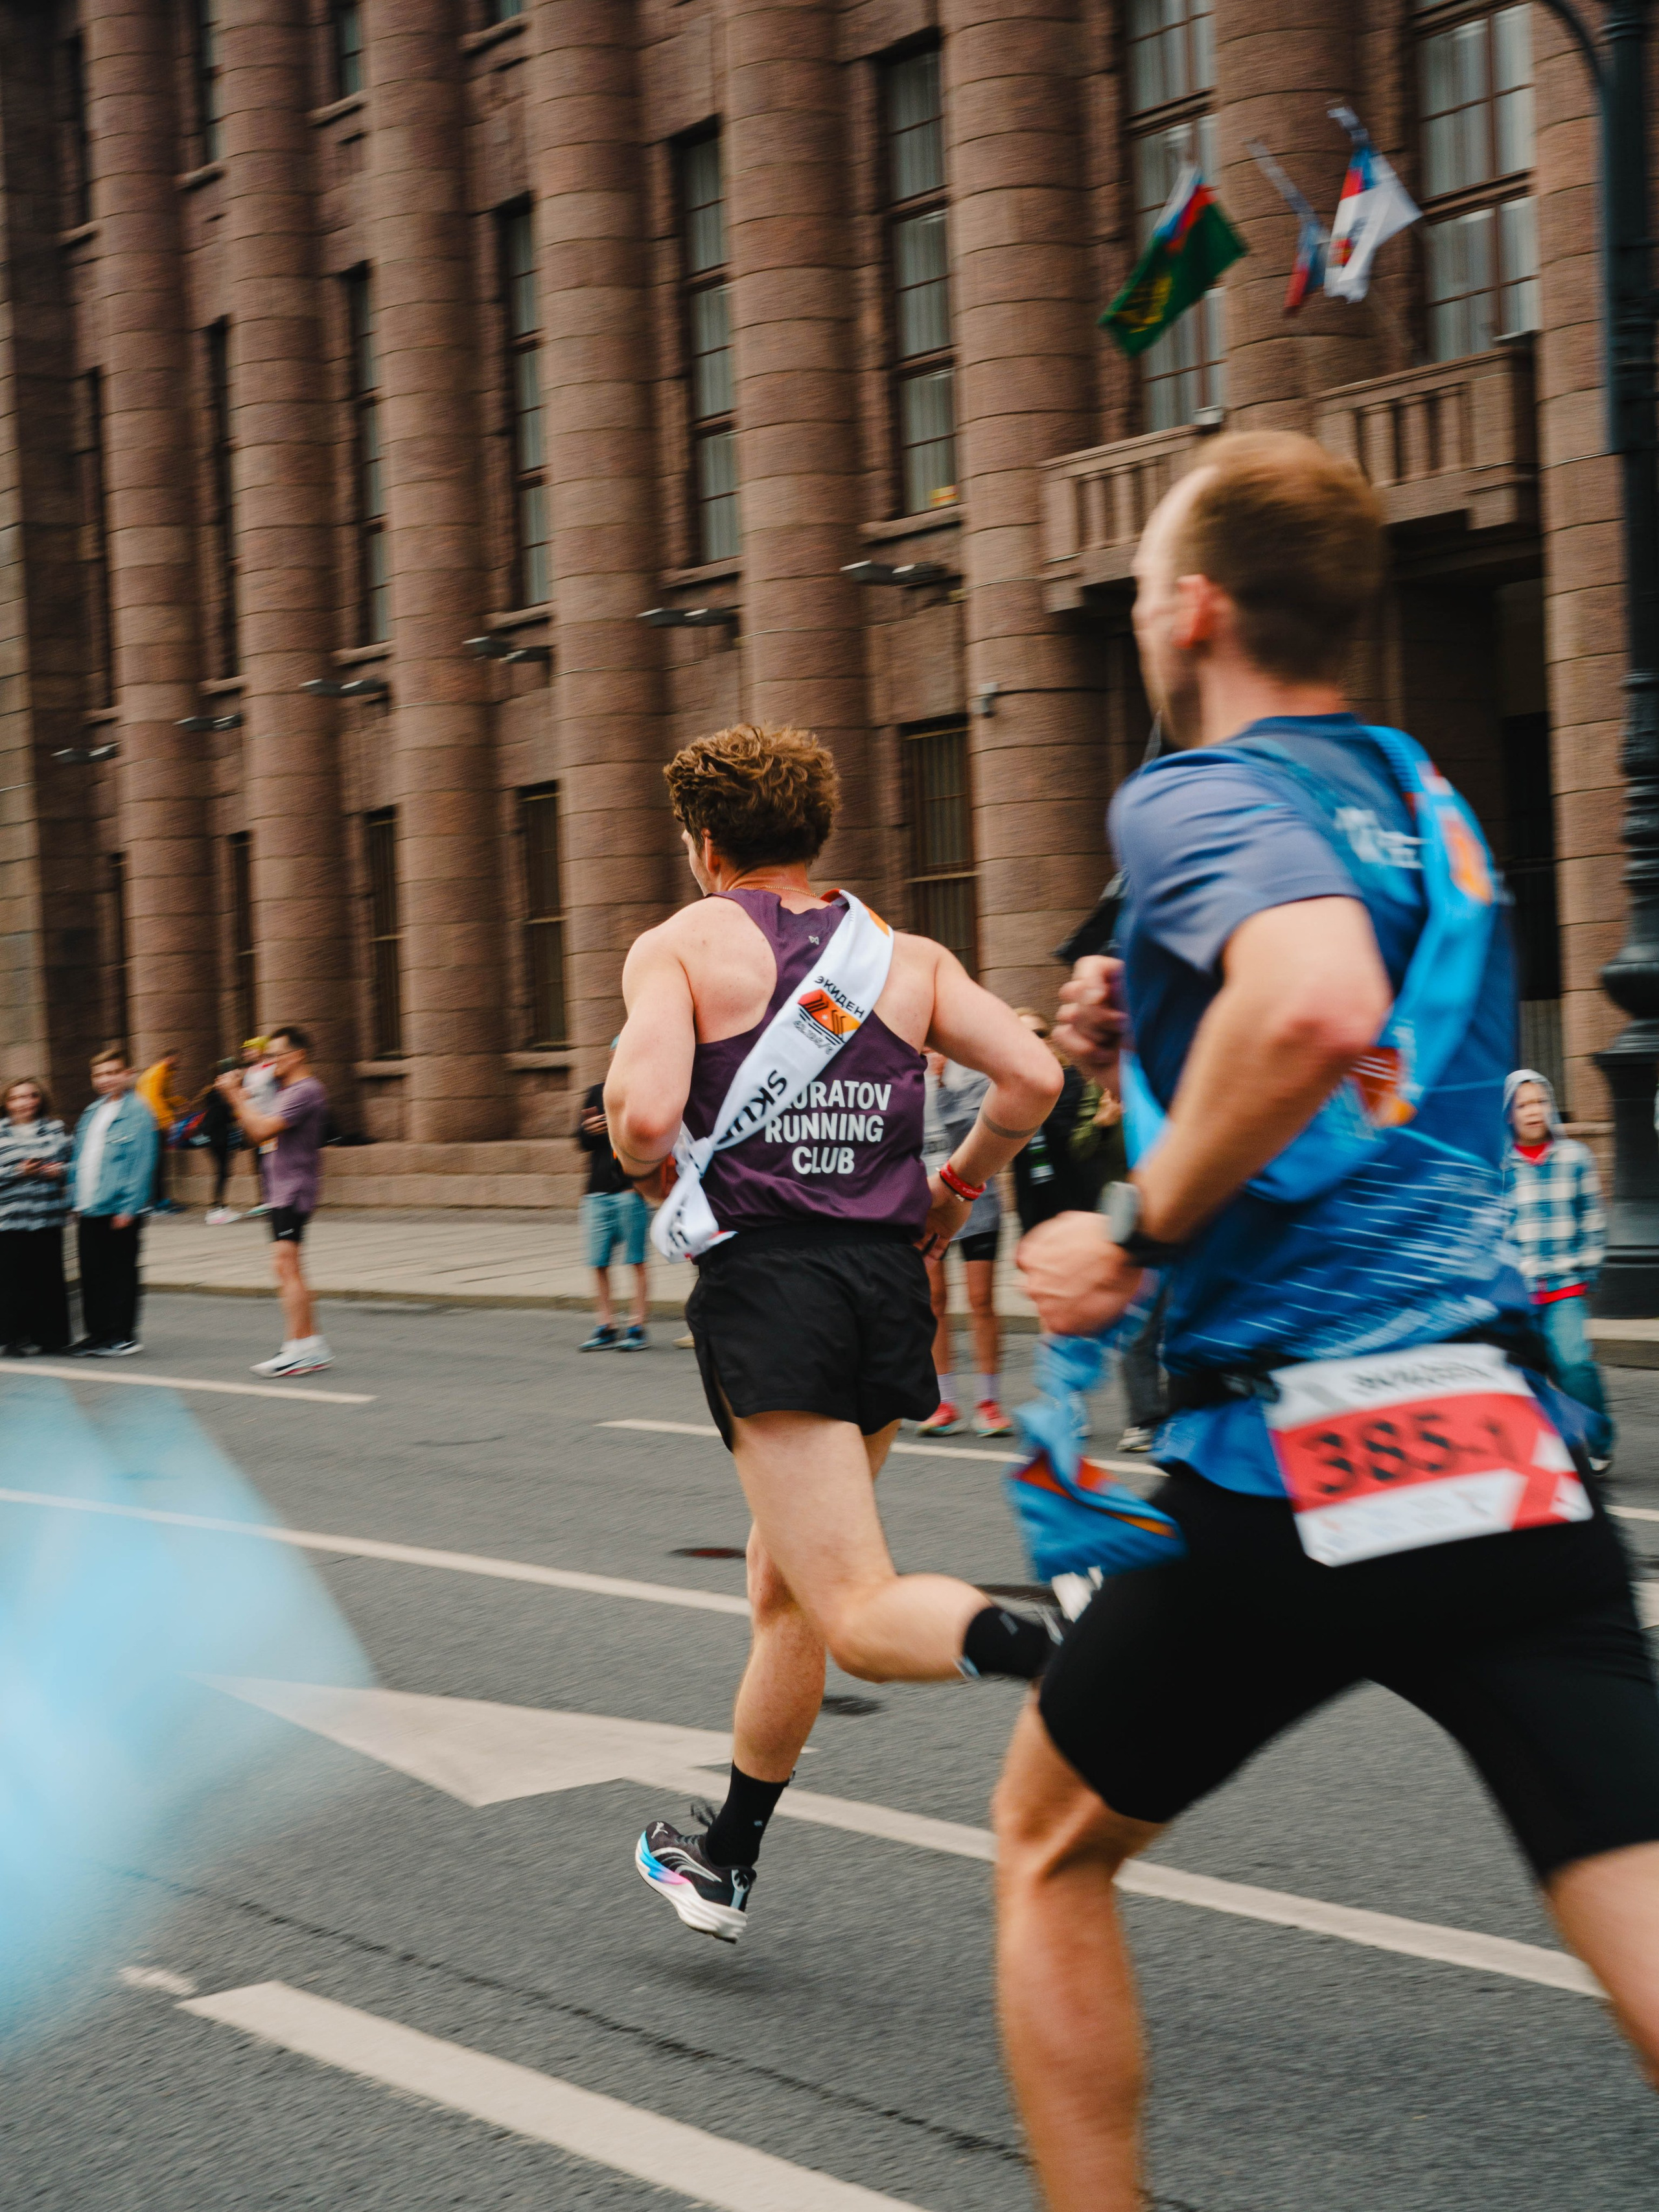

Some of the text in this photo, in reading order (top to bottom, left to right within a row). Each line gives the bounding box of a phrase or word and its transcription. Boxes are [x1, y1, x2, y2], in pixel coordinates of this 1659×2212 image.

[815, 975, 864, 1018] ЭКИДЕН
[765, 1113, 884, 1143] RUNNING
[792, 1146, 855, 1174] CLUB
